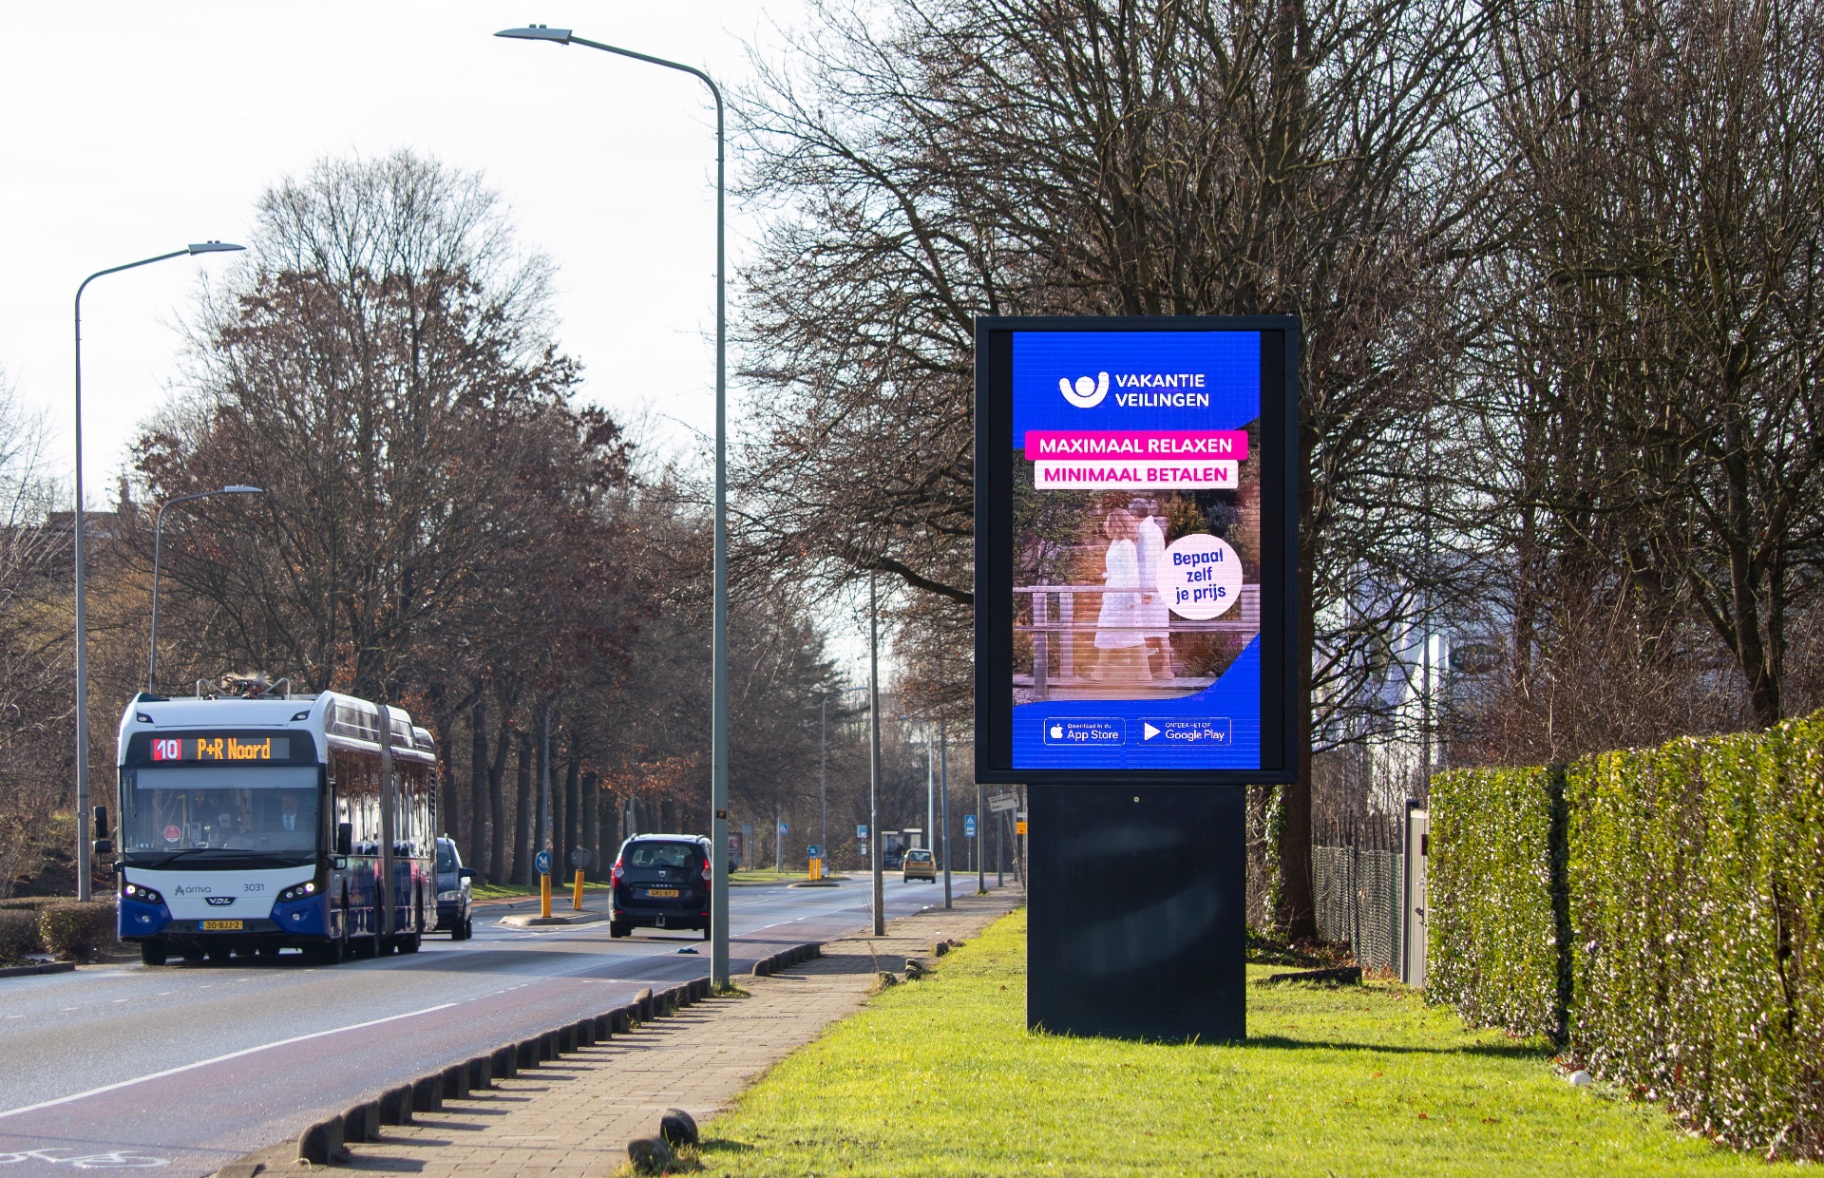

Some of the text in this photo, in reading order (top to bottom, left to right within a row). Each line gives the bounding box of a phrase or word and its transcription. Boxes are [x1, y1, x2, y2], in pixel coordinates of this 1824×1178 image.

[1115, 373, 1206, 388] VAKANTIE
[1115, 392, 1210, 407] VEILINGEN
[1039, 438, 1233, 453] MAXIMAAL RELAXEN
[1044, 467, 1228, 482] MINIMAAL BETALEN
[1173, 548, 1223, 567] Bepaal
[1186, 566, 1212, 582] zelf
[1176, 583, 1226, 604] je prijs
[1067, 730, 1119, 742] App Store
[1165, 729, 1225, 742] Google Play
[157, 737, 271, 760] 10 P+R Noord
[185, 885, 212, 894] arriva
[243, 883, 265, 892] 3031
